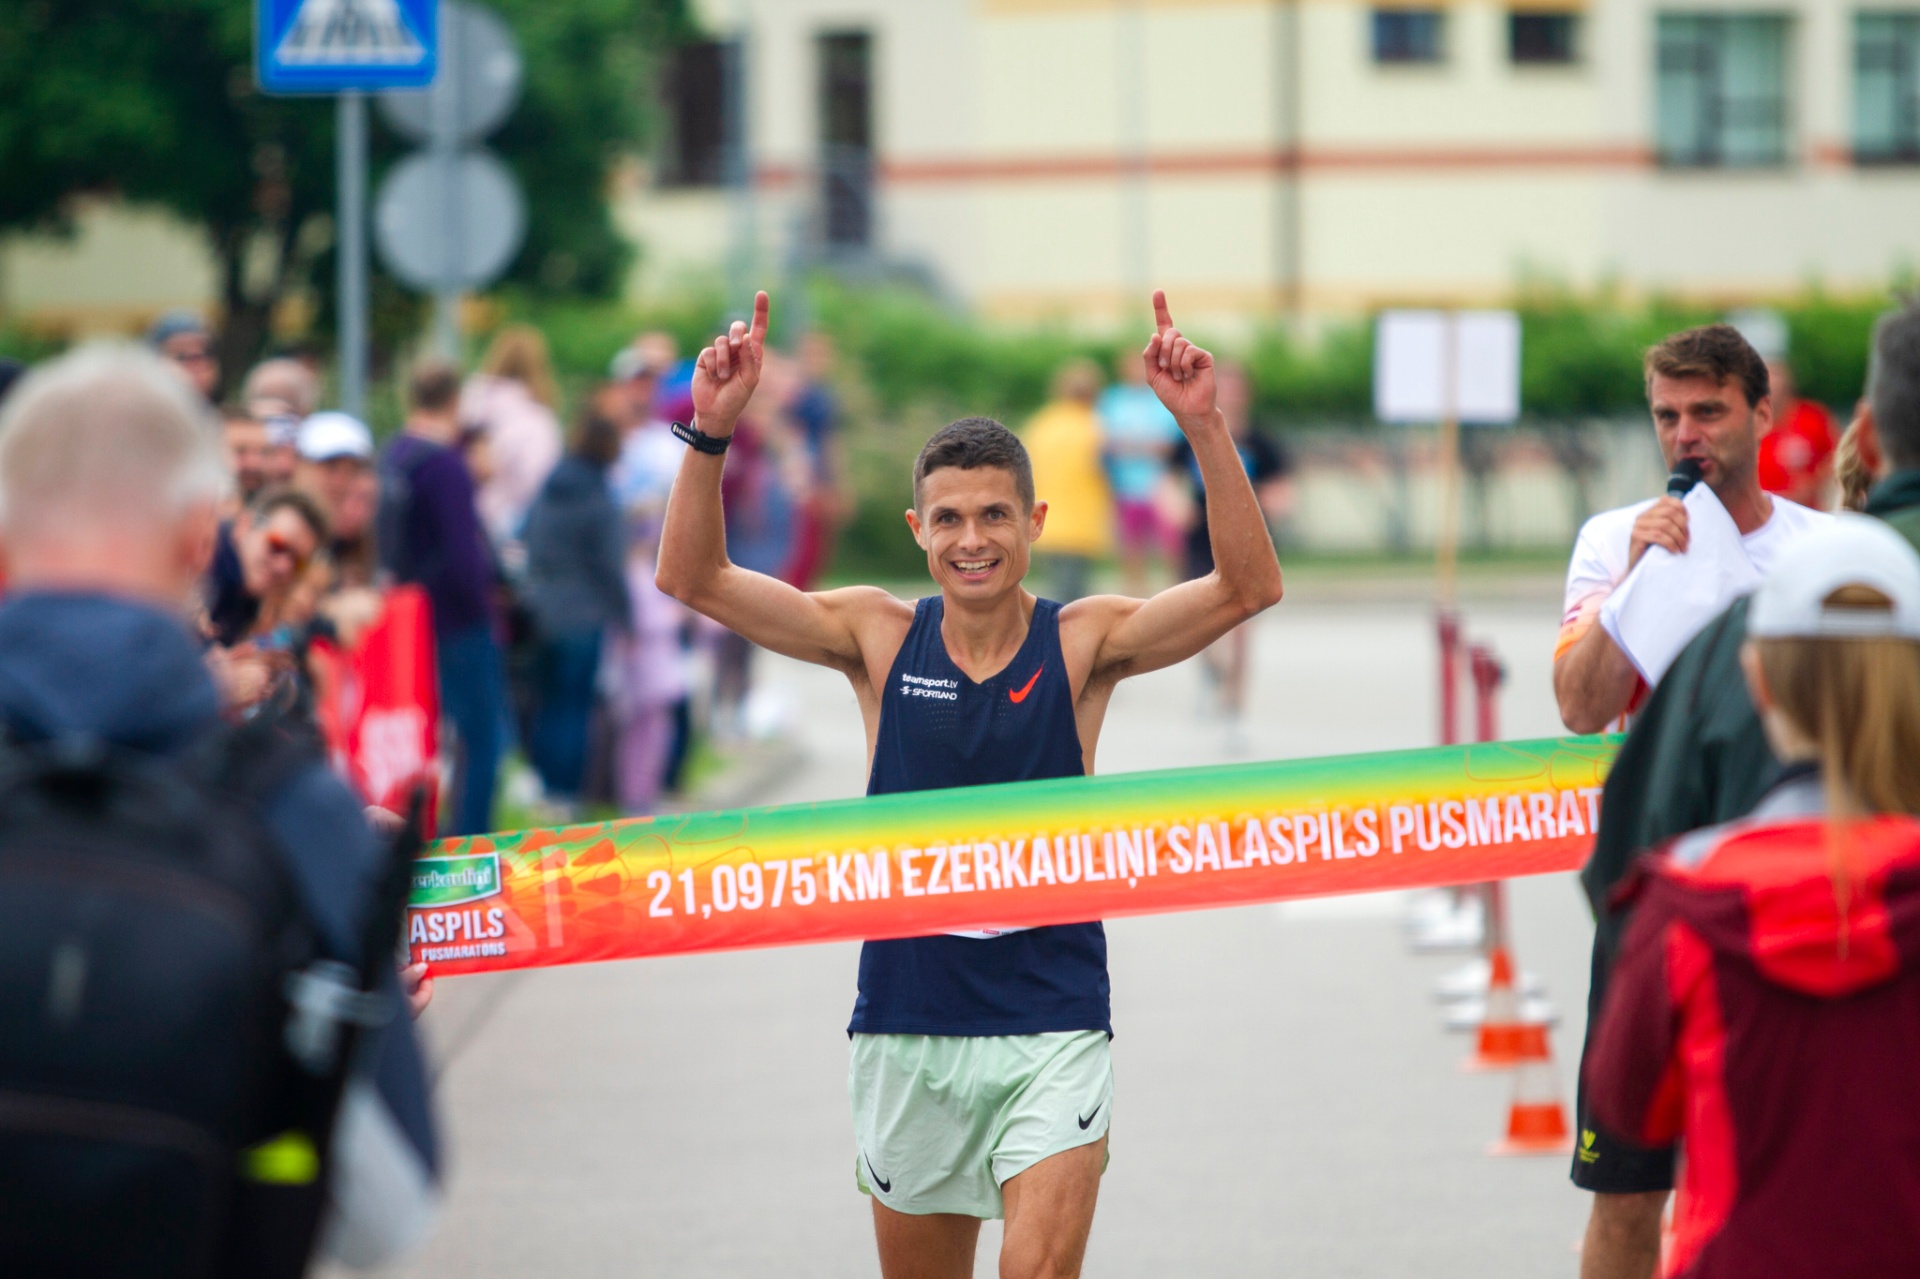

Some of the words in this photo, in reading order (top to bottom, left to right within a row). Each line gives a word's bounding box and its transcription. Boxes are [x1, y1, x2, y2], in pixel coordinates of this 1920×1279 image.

[902, 673, 959, 689] teamsport.lv
[911, 687, 958, 701] SPORTLAND
[647, 857, 817, 920] 21,0975
[826, 850, 891, 904] KM
[900, 828, 1158, 897] EZERKAULIŅI
[1166, 808, 1381, 875] SALASPILS
[1389, 786, 1604, 855] PUSMARAT
[410, 907, 505, 944] ASPILS
[421, 941, 506, 962] PUSMARATONS
